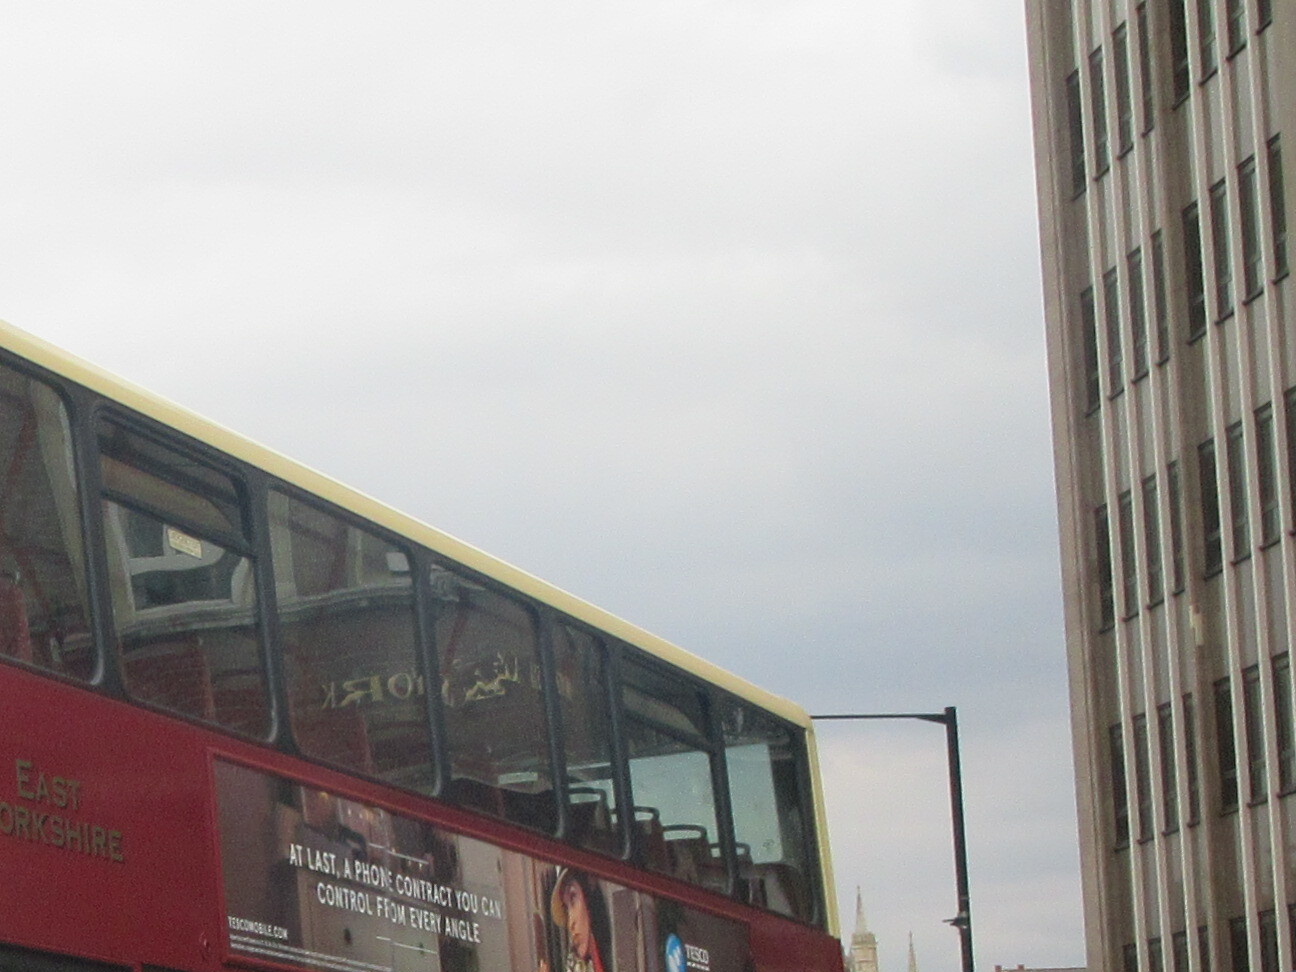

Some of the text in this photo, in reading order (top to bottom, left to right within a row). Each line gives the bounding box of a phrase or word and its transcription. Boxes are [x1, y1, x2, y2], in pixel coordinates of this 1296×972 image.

[16, 759, 80, 811] EAST
[289, 843, 502, 920] AT LAST, A PHONE CONTRACT YOU CAN
[317, 882, 372, 916] CONTROL
[409, 906, 442, 934] EVERY
[444, 916, 481, 944] ANGLE
